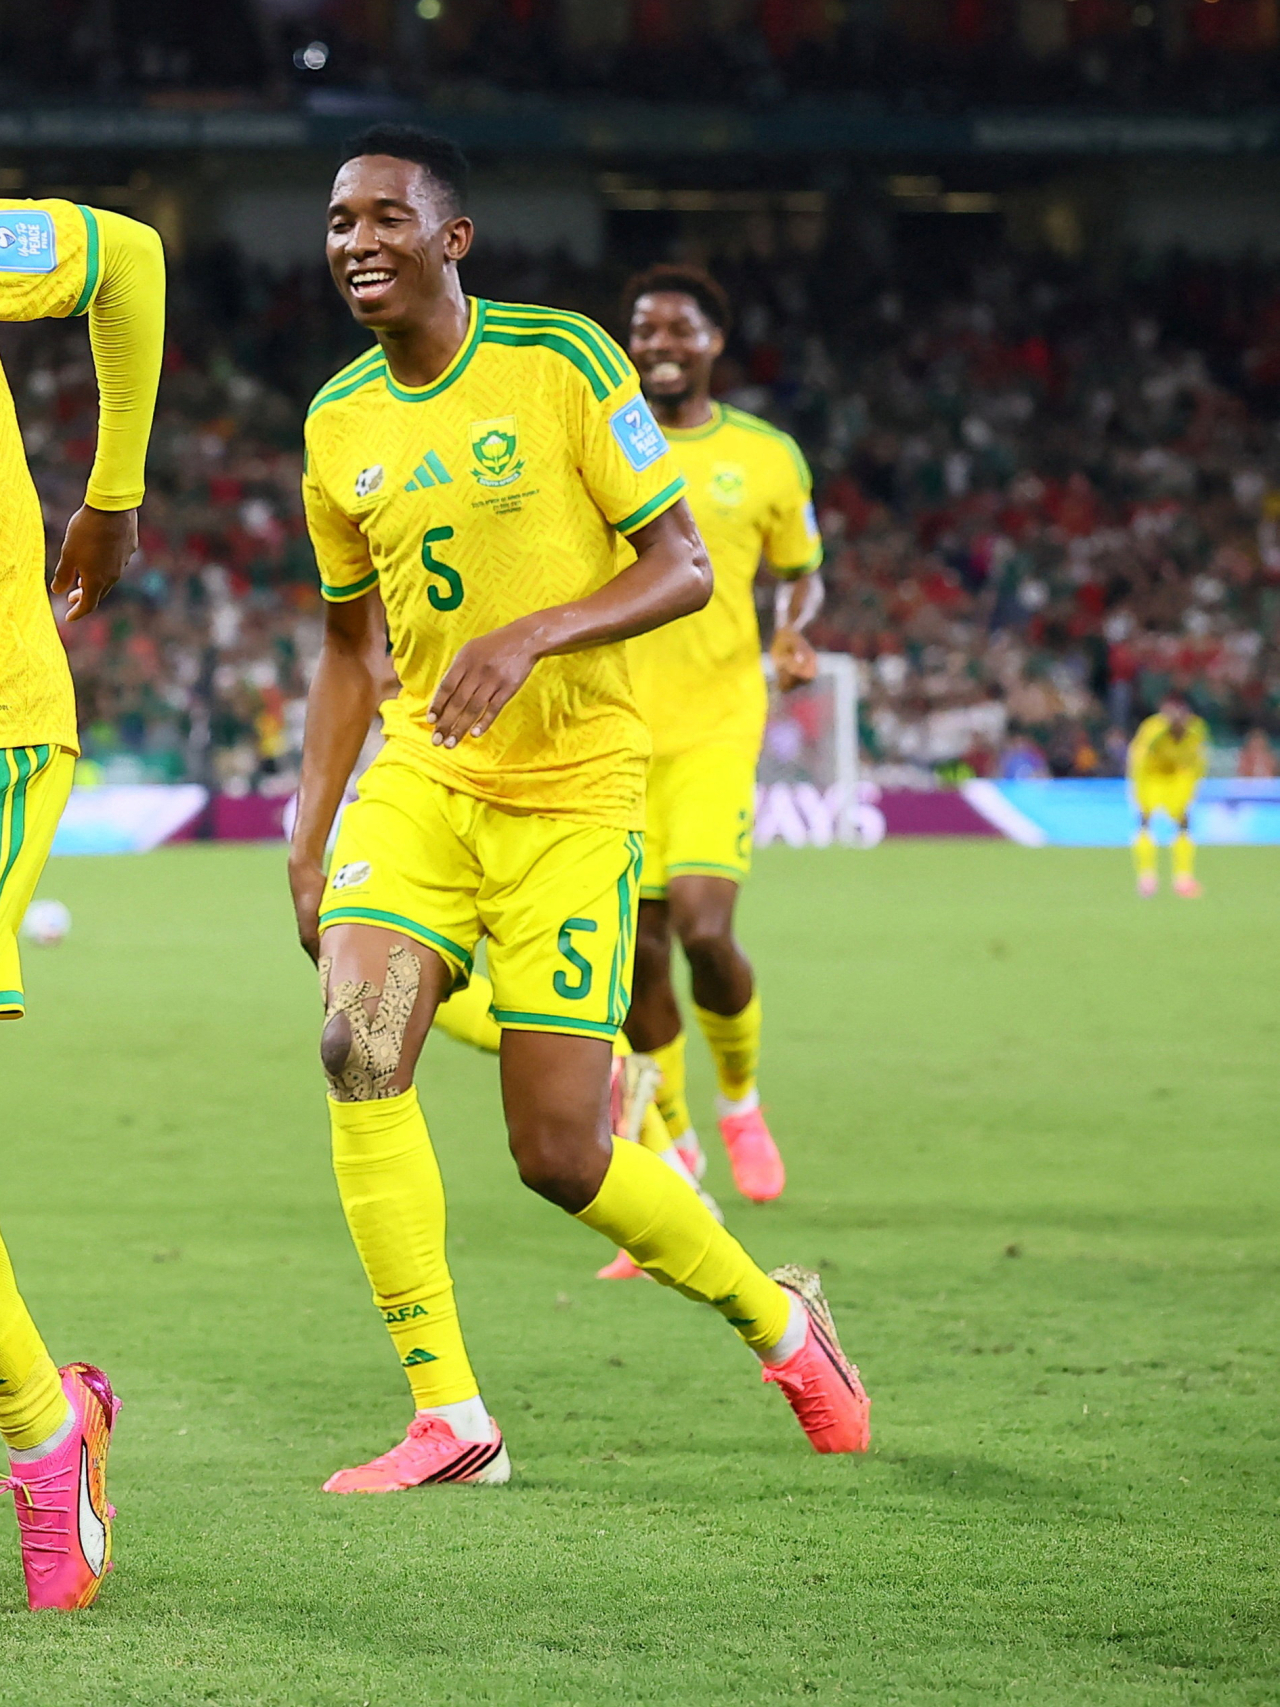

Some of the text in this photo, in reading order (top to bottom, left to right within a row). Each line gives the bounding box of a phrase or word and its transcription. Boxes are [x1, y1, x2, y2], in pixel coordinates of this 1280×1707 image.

[27, 224, 42, 255] PEACE
[422, 526, 464, 611] 5
[553, 917, 598, 999] 5
